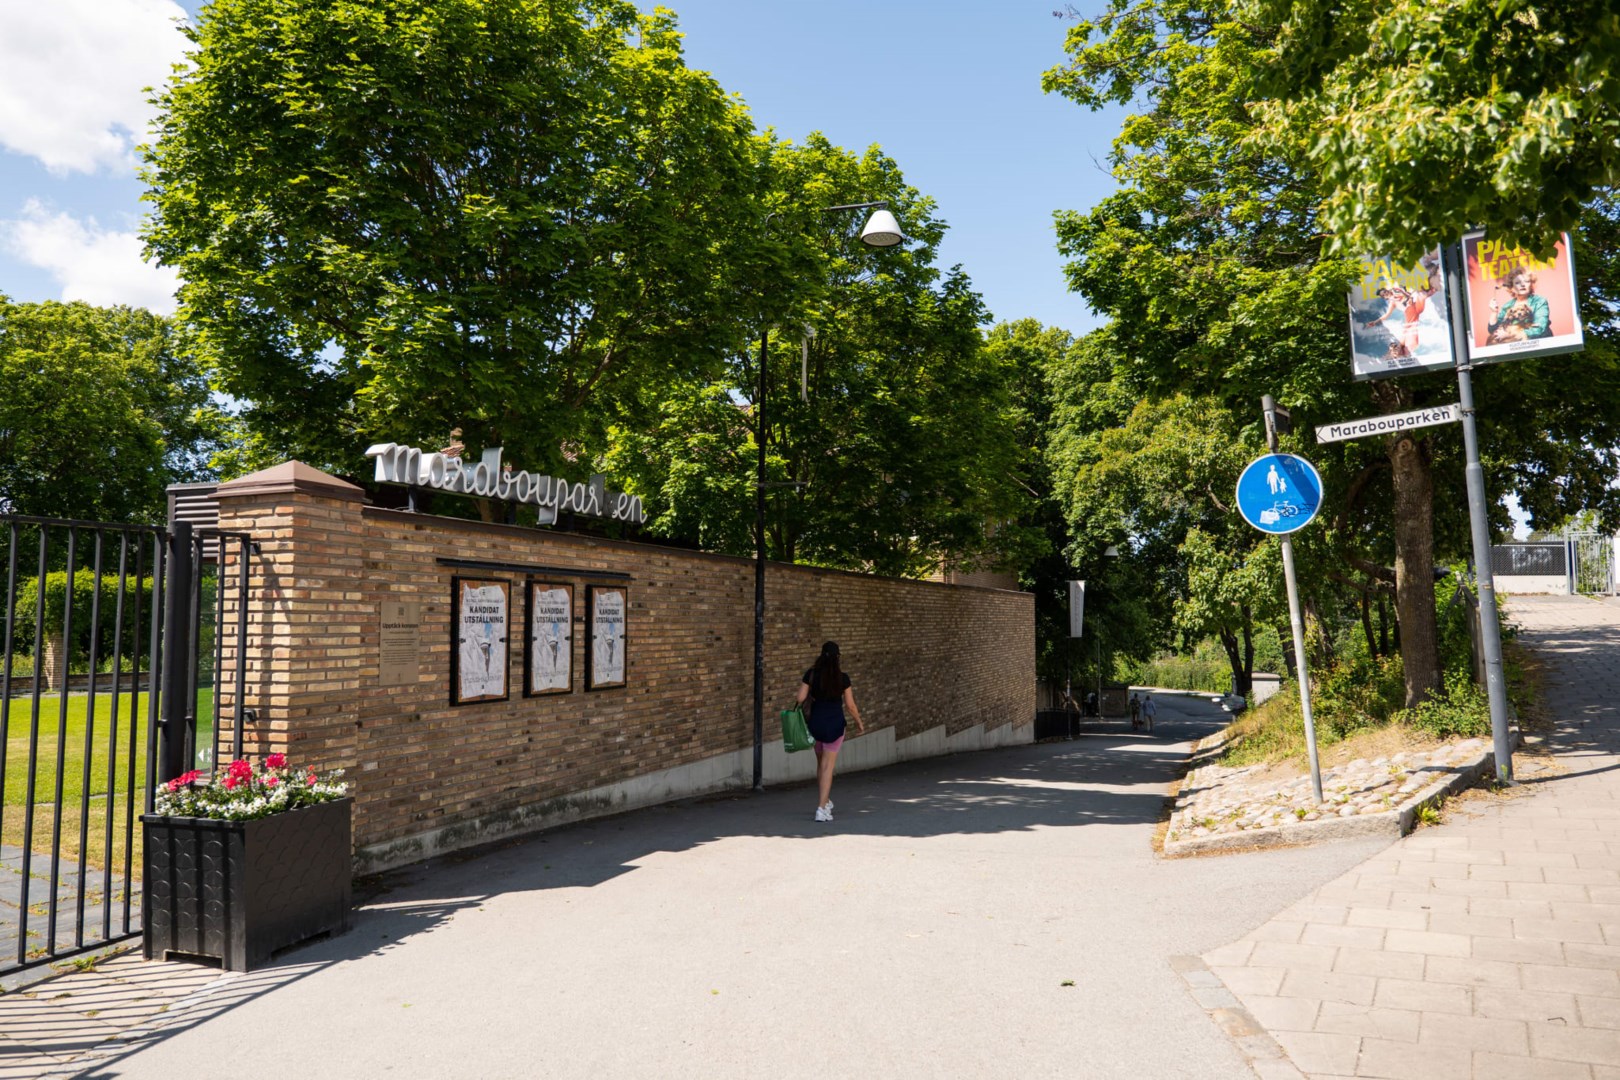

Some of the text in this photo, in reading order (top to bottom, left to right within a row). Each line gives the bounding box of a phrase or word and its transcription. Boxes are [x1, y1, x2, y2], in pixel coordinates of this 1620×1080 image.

[1330, 410, 1451, 438] Marabouparken
[364, 442, 648, 525] Marabouparen
[469, 605, 500, 614] KANDIDAT
[540, 607, 565, 615] KANDIDAT
[598, 608, 620, 616] KANDIDAT
